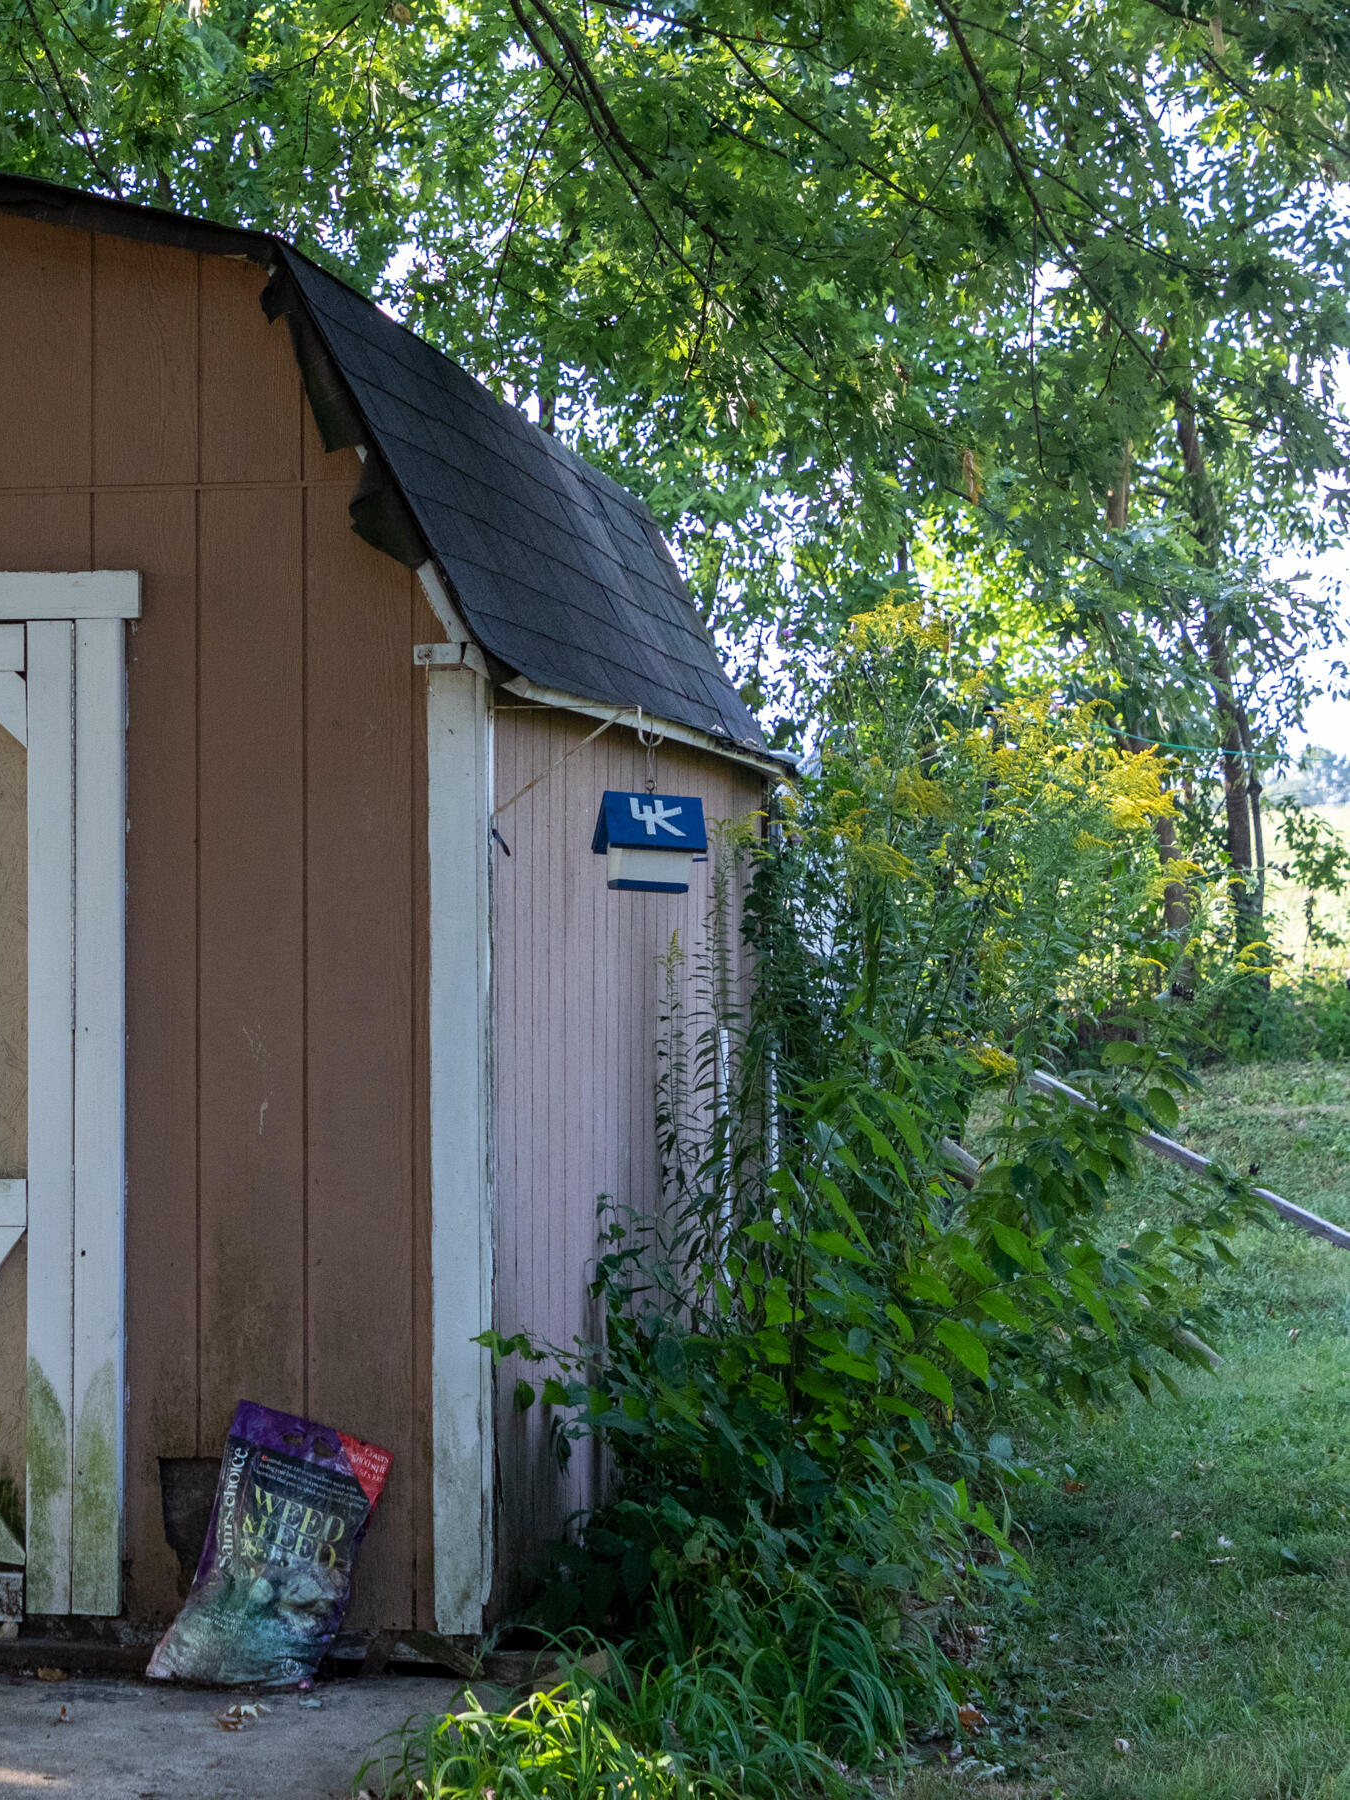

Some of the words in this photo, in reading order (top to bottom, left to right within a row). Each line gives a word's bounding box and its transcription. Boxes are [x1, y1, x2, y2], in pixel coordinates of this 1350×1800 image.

[629, 797, 687, 836] UK
[254, 1483, 345, 1542] WEED
[256, 1515, 337, 1569] FEED
